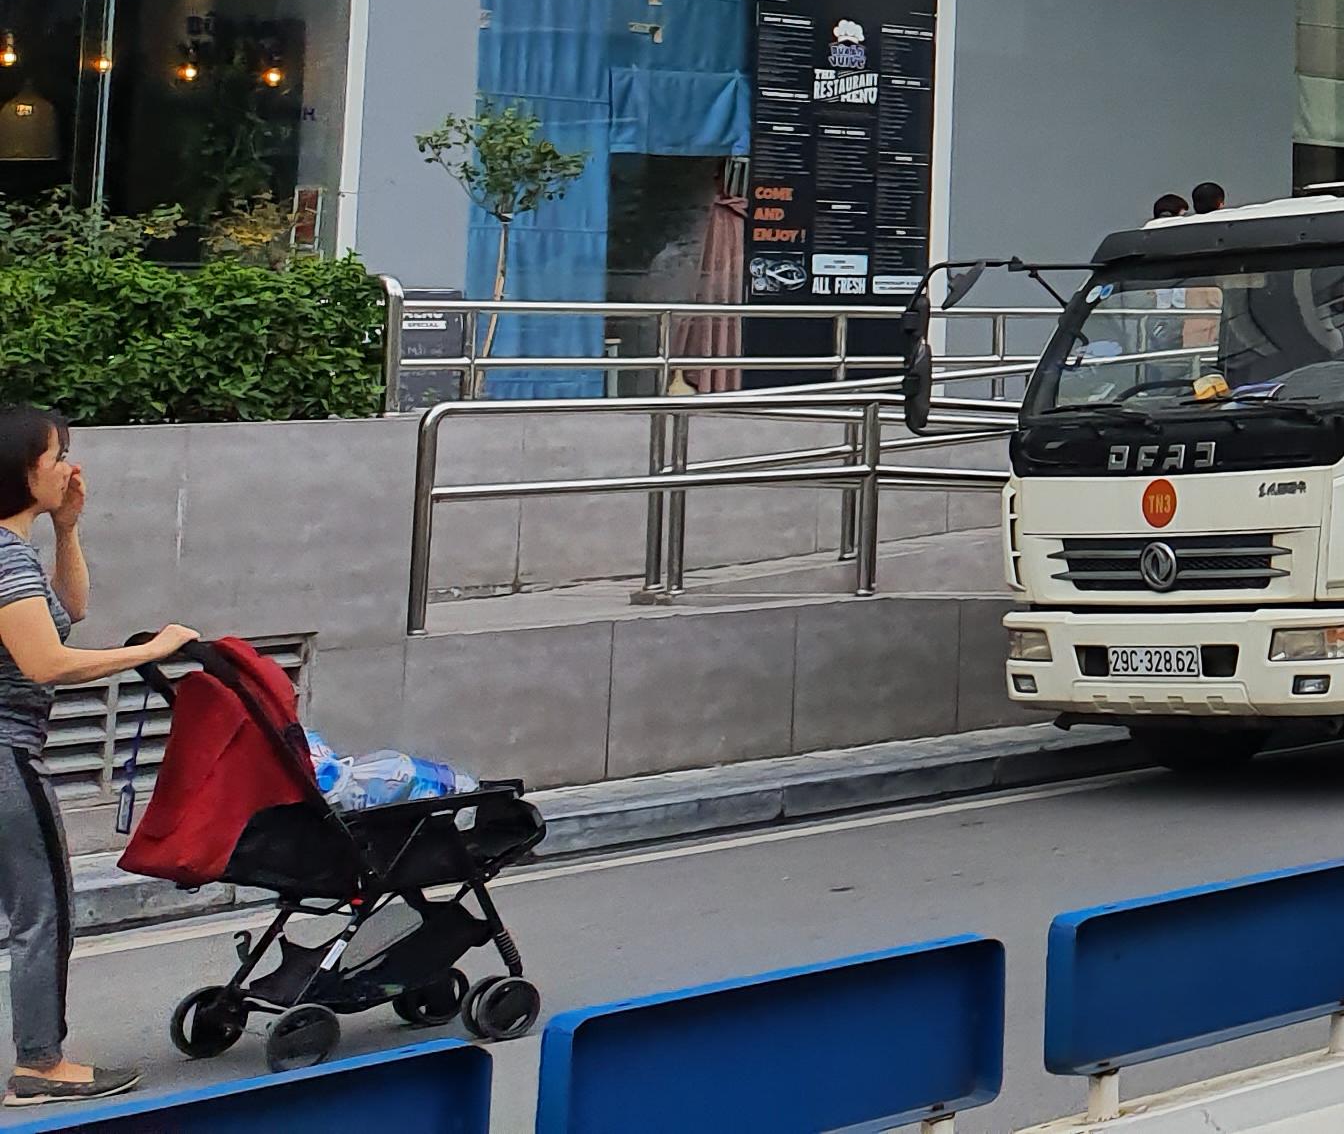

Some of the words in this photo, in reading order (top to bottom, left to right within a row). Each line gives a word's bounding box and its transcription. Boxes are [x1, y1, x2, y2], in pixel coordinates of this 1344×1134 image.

[814, 68, 836, 79] THE
[813, 73, 878, 100] RESTAURANT
[841, 87, 878, 104] MENU
[755, 186, 794, 201] COME
[754, 207, 785, 221] AND
[812, 277, 831, 294] ALL
[834, 277, 866, 295] FRESH
[1149, 493, 1171, 514] TN3
[1111, 650, 1196, 673] 29C-328.62
